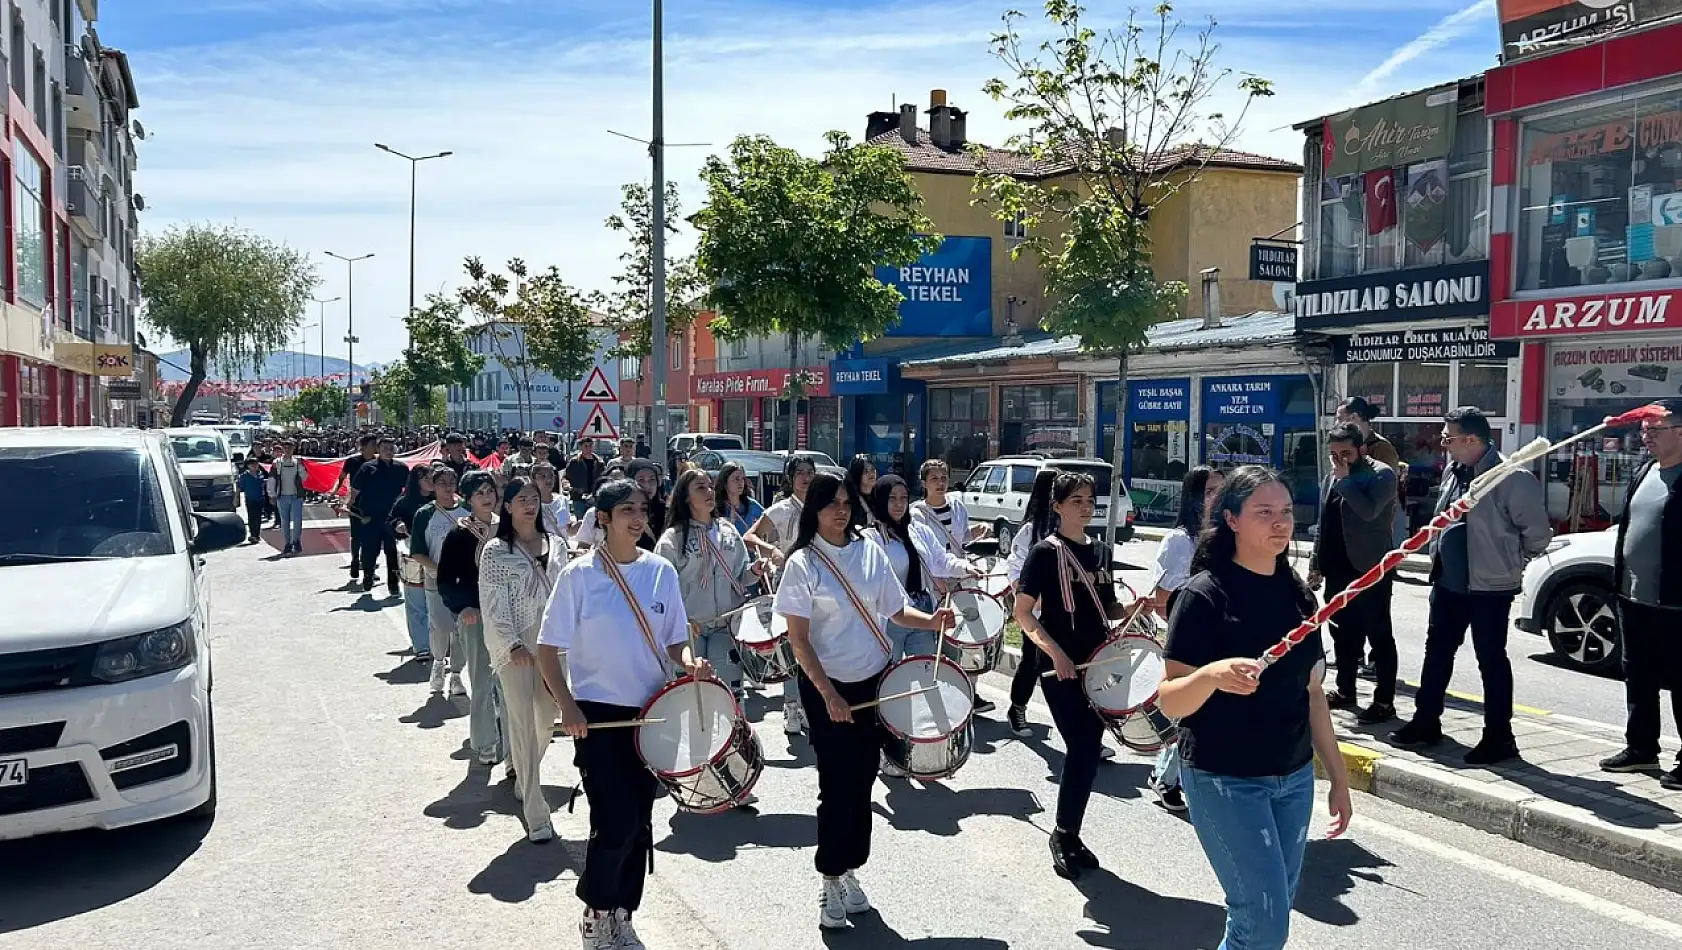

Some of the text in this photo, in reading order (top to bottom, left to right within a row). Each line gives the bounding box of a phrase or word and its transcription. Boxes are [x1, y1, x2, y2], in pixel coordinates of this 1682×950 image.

[899, 266, 970, 284] REYHAN
[907, 284, 963, 302] TEKEL
[1295, 275, 1482, 318] YILDIZLAR SALONU
[1523, 295, 1672, 331] ARZUM
[1349, 335, 1399, 347] YILDIZLAR
[1346, 342, 1496, 361] SALONUMUZ DUŞAKABİNLİDİR
[1553, 350, 1587, 367] ARZUM
[726, 375, 744, 393] Pide
[836, 372, 860, 382] REYHAN
[861, 370, 882, 381] TEKEL
[1210, 381, 1271, 393] ANKARA TARIM
[1231, 395, 1248, 405] YEM
